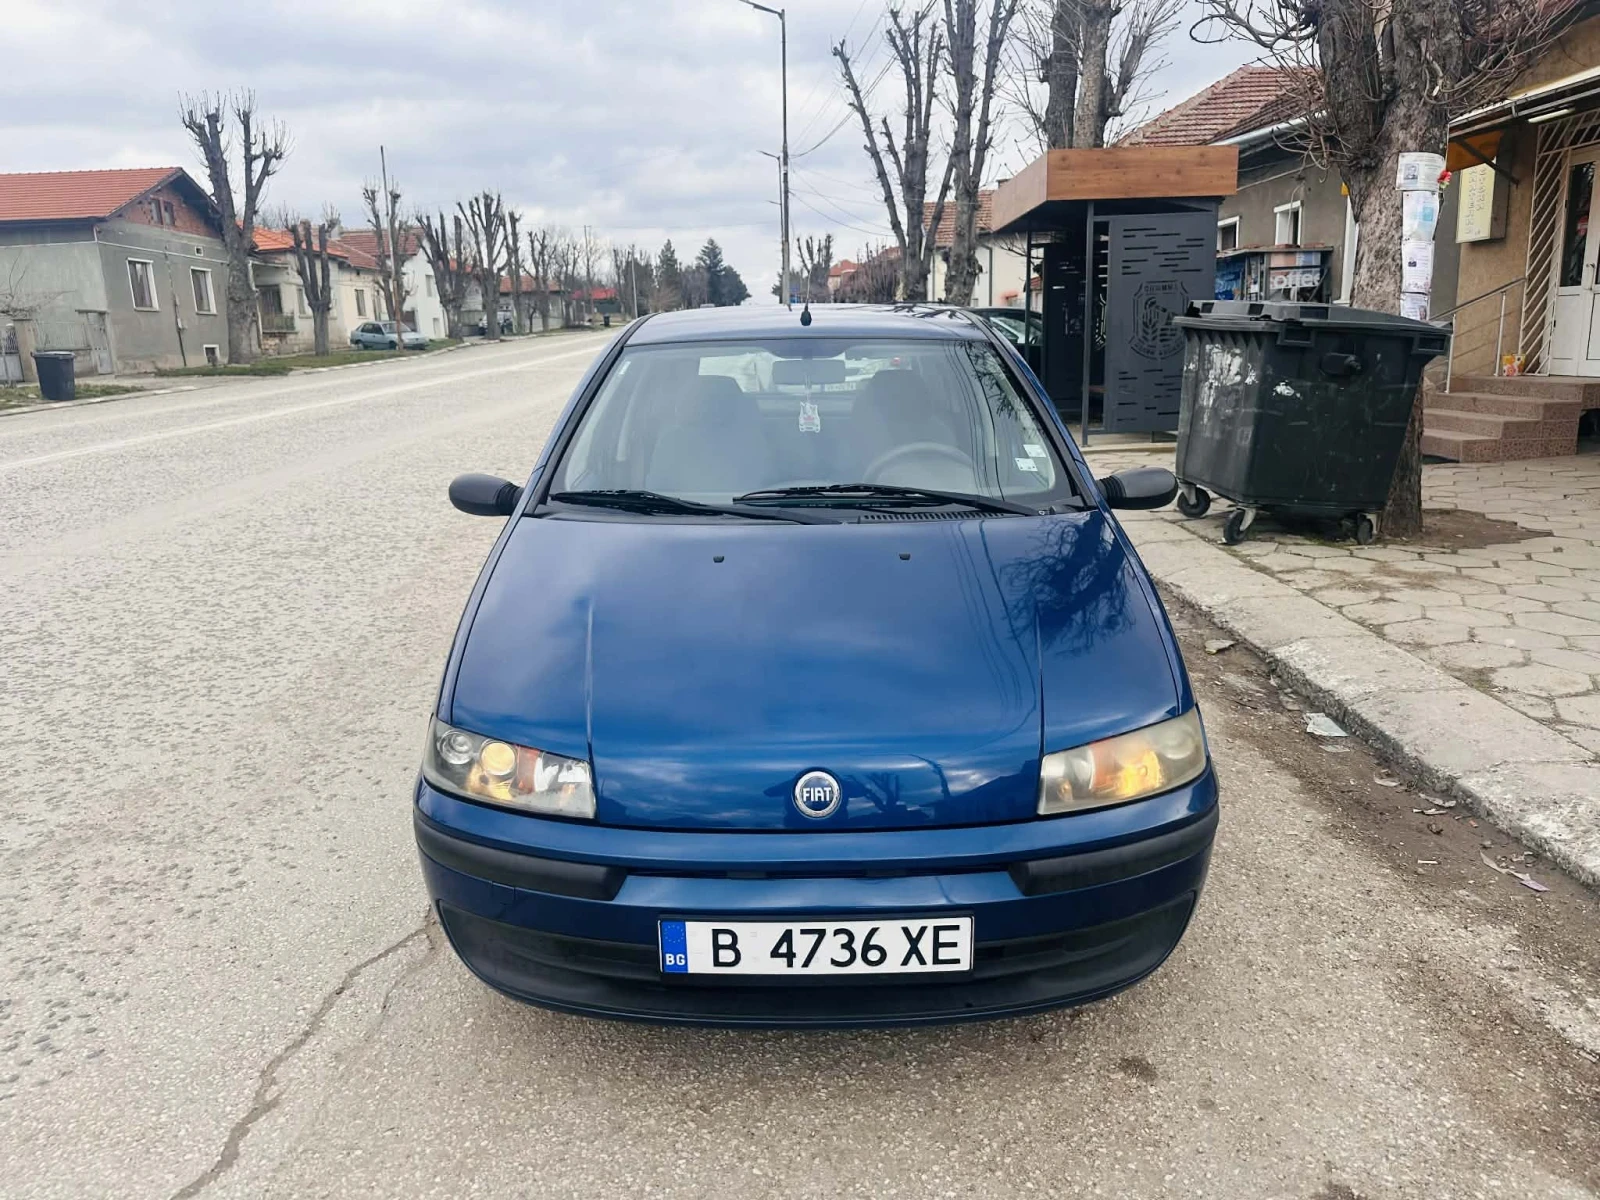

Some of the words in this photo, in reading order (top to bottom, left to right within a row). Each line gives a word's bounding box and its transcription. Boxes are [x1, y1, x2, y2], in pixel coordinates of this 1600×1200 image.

[802, 787, 832, 802] FIAT
[711, 928, 742, 968] B
[769, 927, 887, 968] 4736
[900, 924, 961, 967] XE
[665, 953, 686, 966] BG
